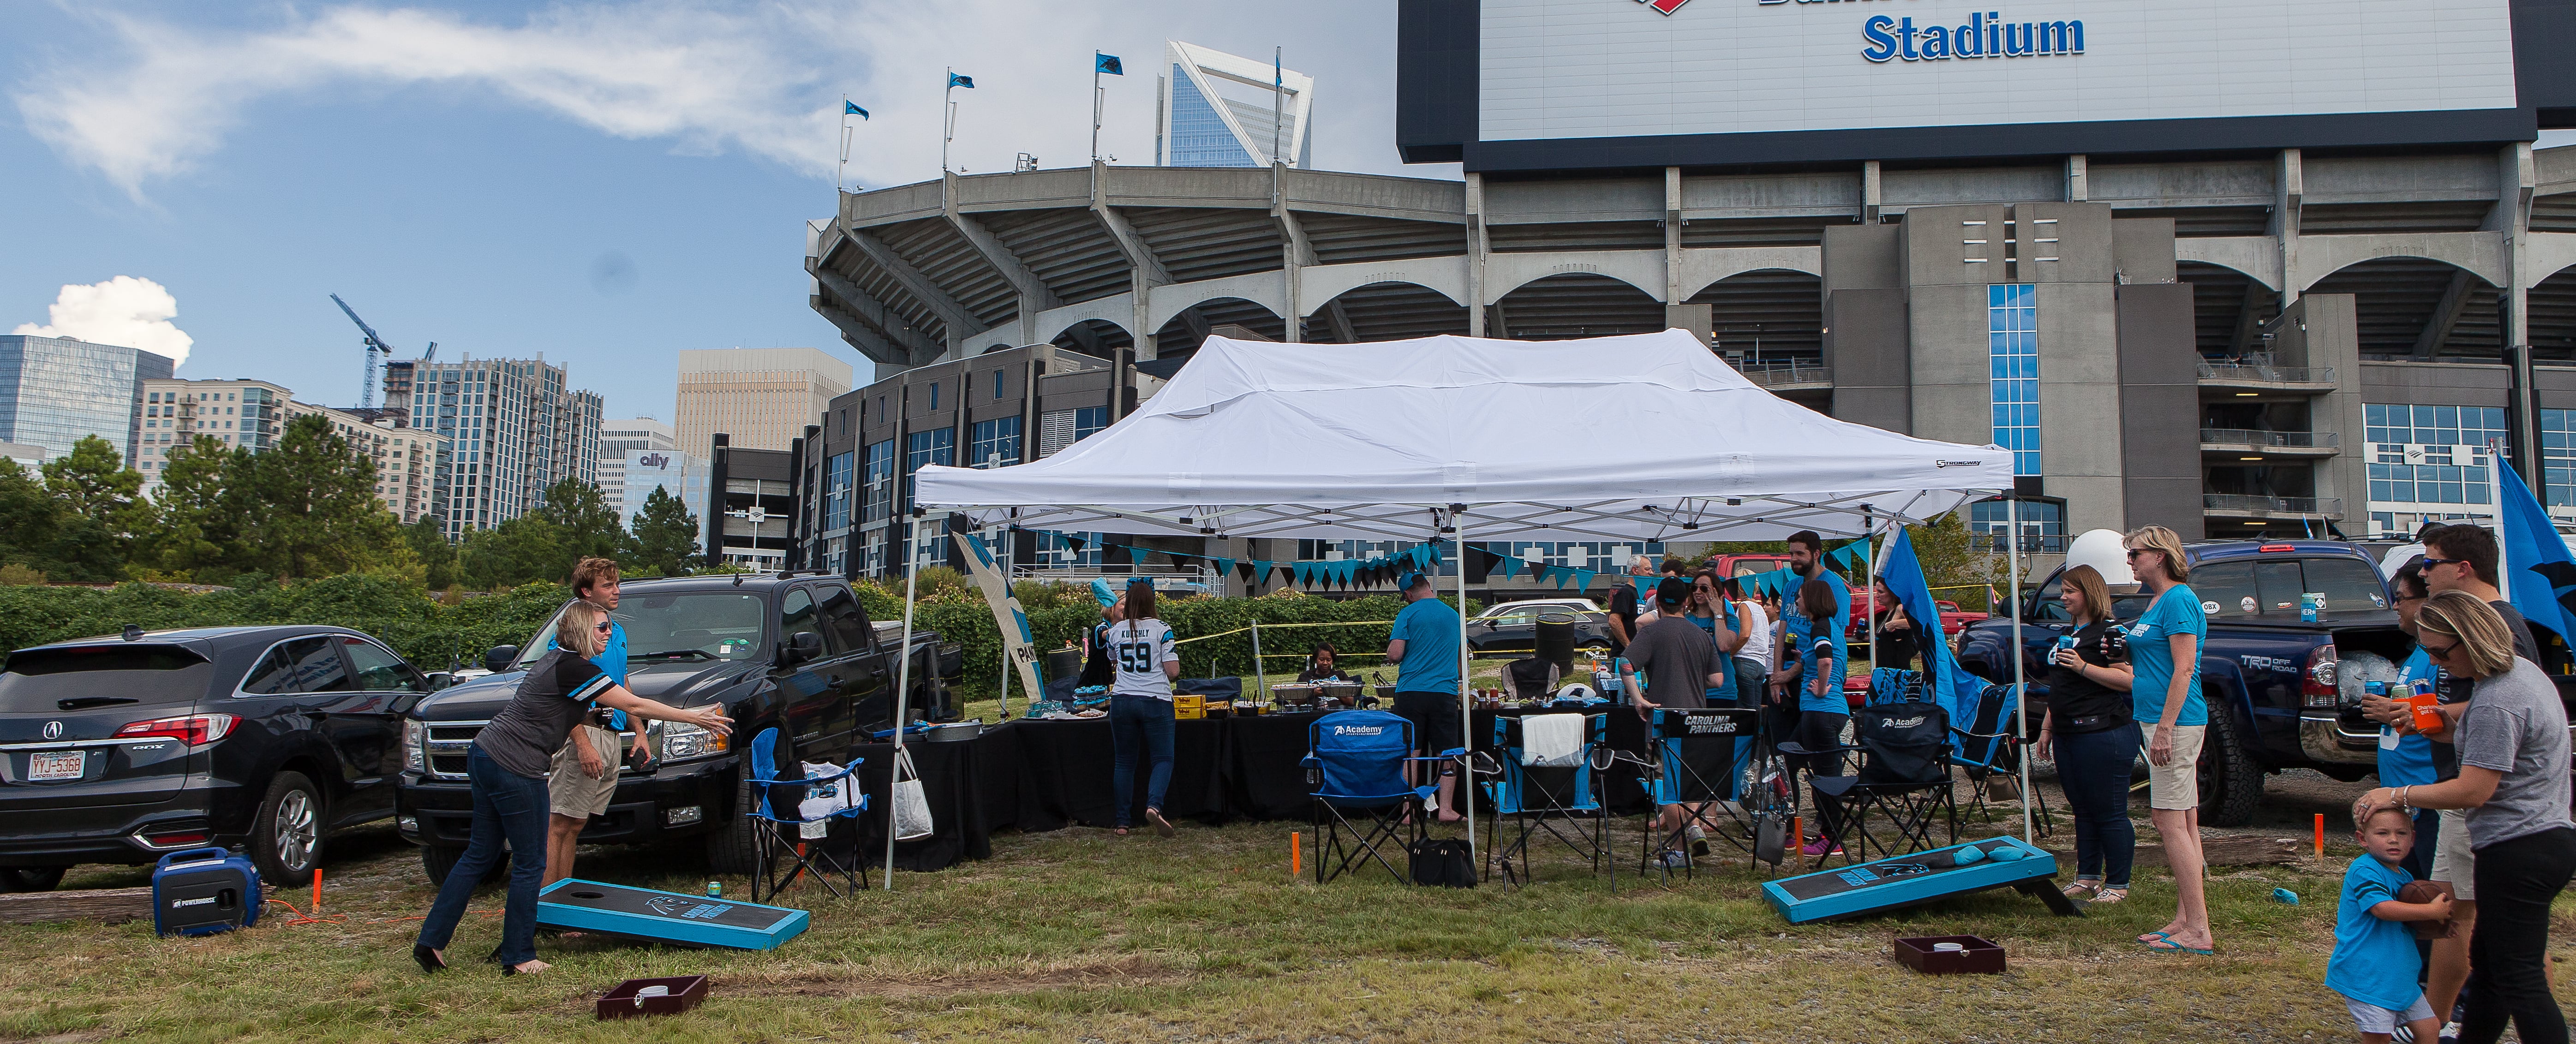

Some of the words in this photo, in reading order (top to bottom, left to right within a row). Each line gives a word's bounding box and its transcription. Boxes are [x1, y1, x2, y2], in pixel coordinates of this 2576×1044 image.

[1861, 11, 2085, 62] Stadium
[640, 453, 669, 470] ally
[1936, 459, 1981, 468] STRONGWAY
[1119, 642, 1152, 673] 59
[2241, 655, 2271, 670] TRD
[1685, 716, 1730, 725] CAROLINA
[1346, 725, 1382, 734] Academy
[1689, 723, 1737, 734] PANTHERS
[34, 758, 81, 773] YYJ-5368
[182, 896, 216, 906] POWERHORSE
